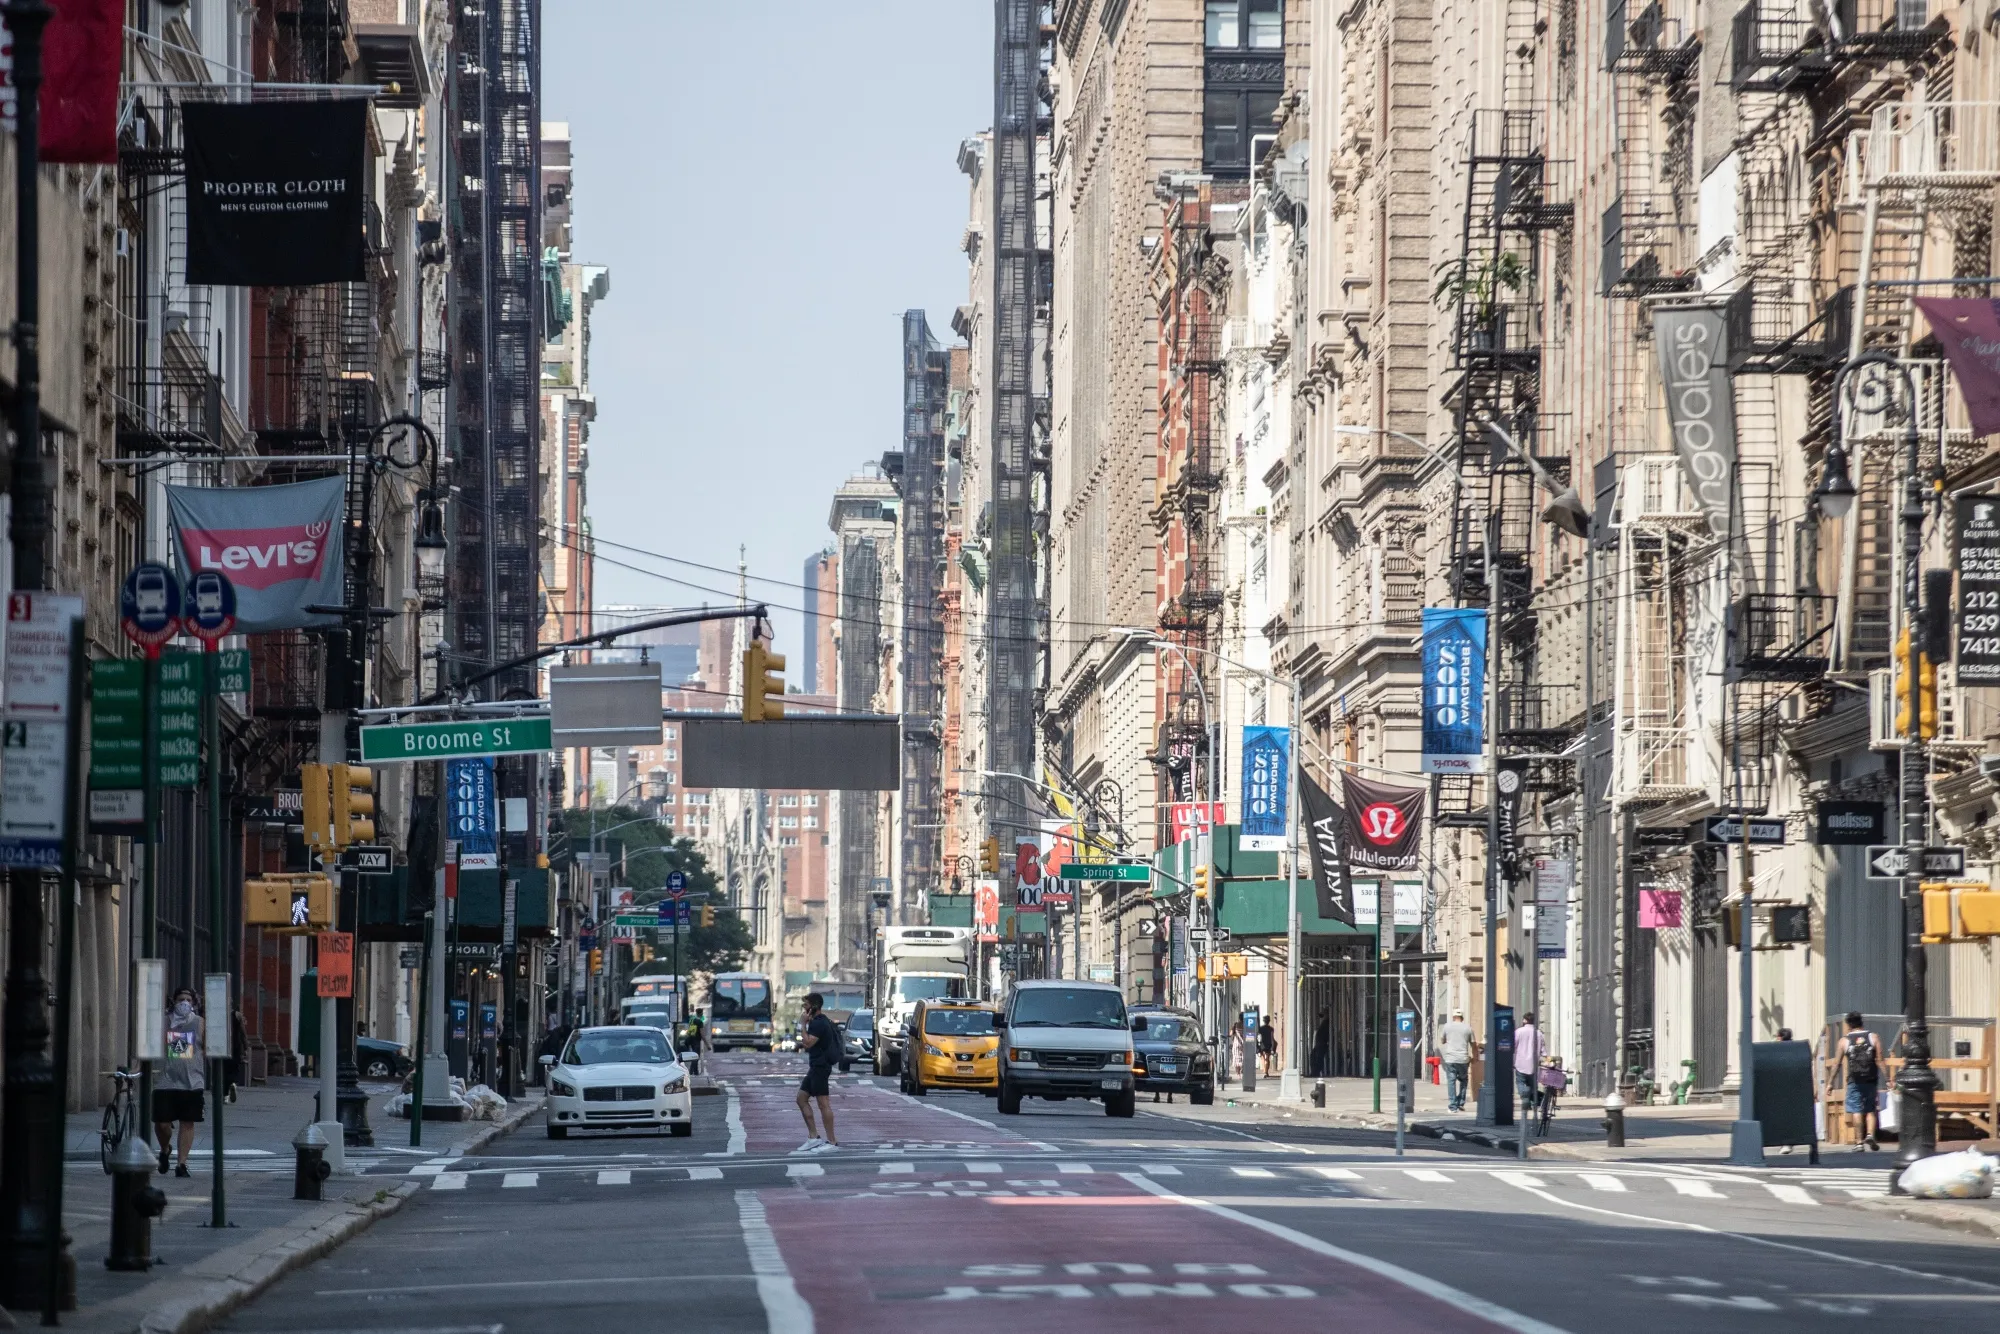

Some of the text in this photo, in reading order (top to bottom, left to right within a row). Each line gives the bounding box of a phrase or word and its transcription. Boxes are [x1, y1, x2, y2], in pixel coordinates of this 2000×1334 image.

[203, 179, 345, 195] PROPER CLOTH
[220, 200, 329, 212] MEN'S CUSTOM CLOTHING
[1969, 520, 1995, 529] THOR
[1962, 530, 2000, 540] EQUITIES
[1960, 547, 2000, 559] RETAIL
[1961, 559, 2000, 571] SPACE
[1961, 571, 2000, 581] AVAILABLE
[15, 595, 27, 620] 3
[1965, 591, 1999, 608] 212
[1964, 614, 1999, 631] 529
[1960, 637, 2000, 655] 7412
[161, 661, 190, 681] SIM1
[1461, 646, 1472, 725] BROADWAY
[11, 722, 23, 747] 2
[404, 727, 512, 752] Broome St
[161, 763, 197, 782] SIM34
[1269, 754, 1280, 815] BROADWAY
[477, 769, 486, 832] BROADWAY
[250, 808, 295, 817] ZARA
[1828, 812, 1873, 828] melissa
[1499, 798, 1517, 862] STANCE
[1718, 825, 1776, 837] ONE WAY
[1313, 817, 1346, 912] ARITZIA
[1350, 846, 1417, 866] lululemon
[1083, 868, 1127, 878] Spring St
[1361, 889, 1374, 897] 530
[631, 917, 653, 925] Prince
[320, 936, 350, 953] RAISE
[321, 975, 350, 992] PLOW
